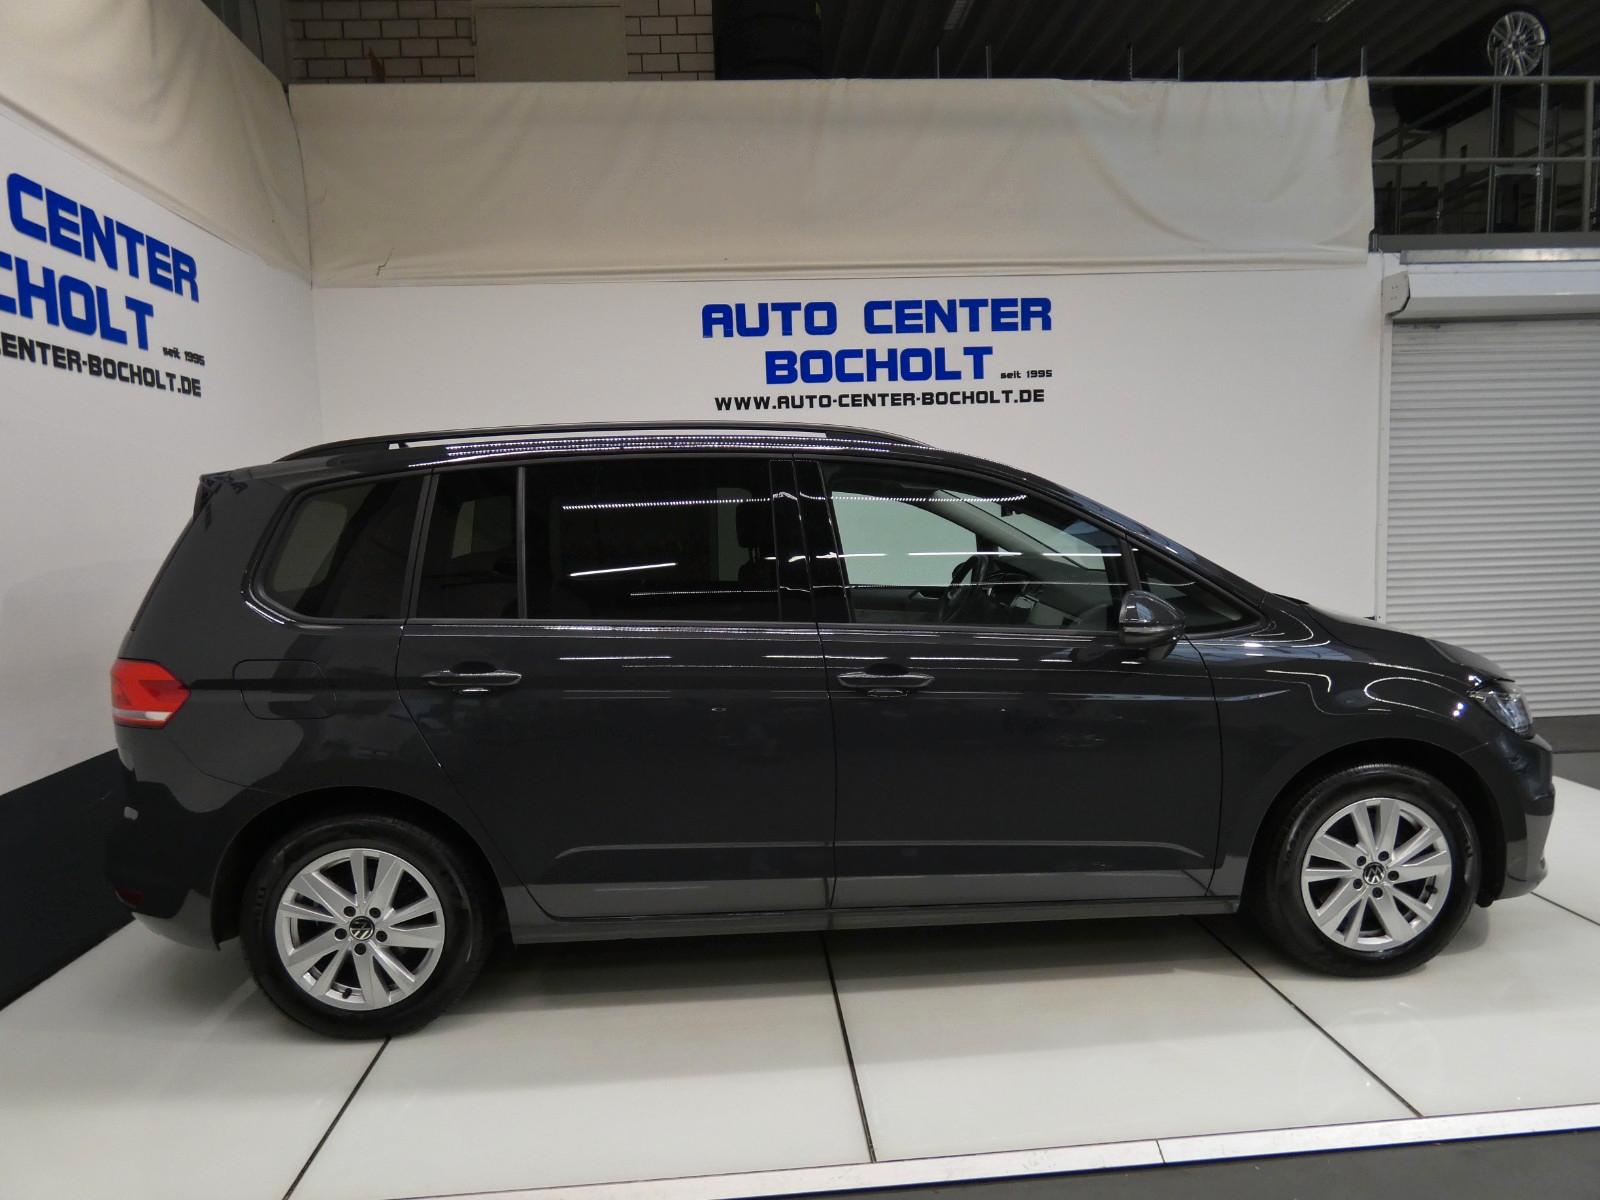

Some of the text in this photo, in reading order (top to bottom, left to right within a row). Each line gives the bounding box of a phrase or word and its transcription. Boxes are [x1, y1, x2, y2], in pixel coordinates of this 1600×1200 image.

[7, 172, 199, 303] CENTER
[701, 297, 1052, 338] AUTO CENTER
[0, 332, 202, 397] ENTER-BOCHOLT.DE
[184, 350, 205, 366] 1995
[765, 346, 993, 385] BOCHOLT
[1000, 369, 1053, 379] seit 1995
[714, 388, 1045, 411] WWW.AUTO-CENTER-BOCHOLT.DE
